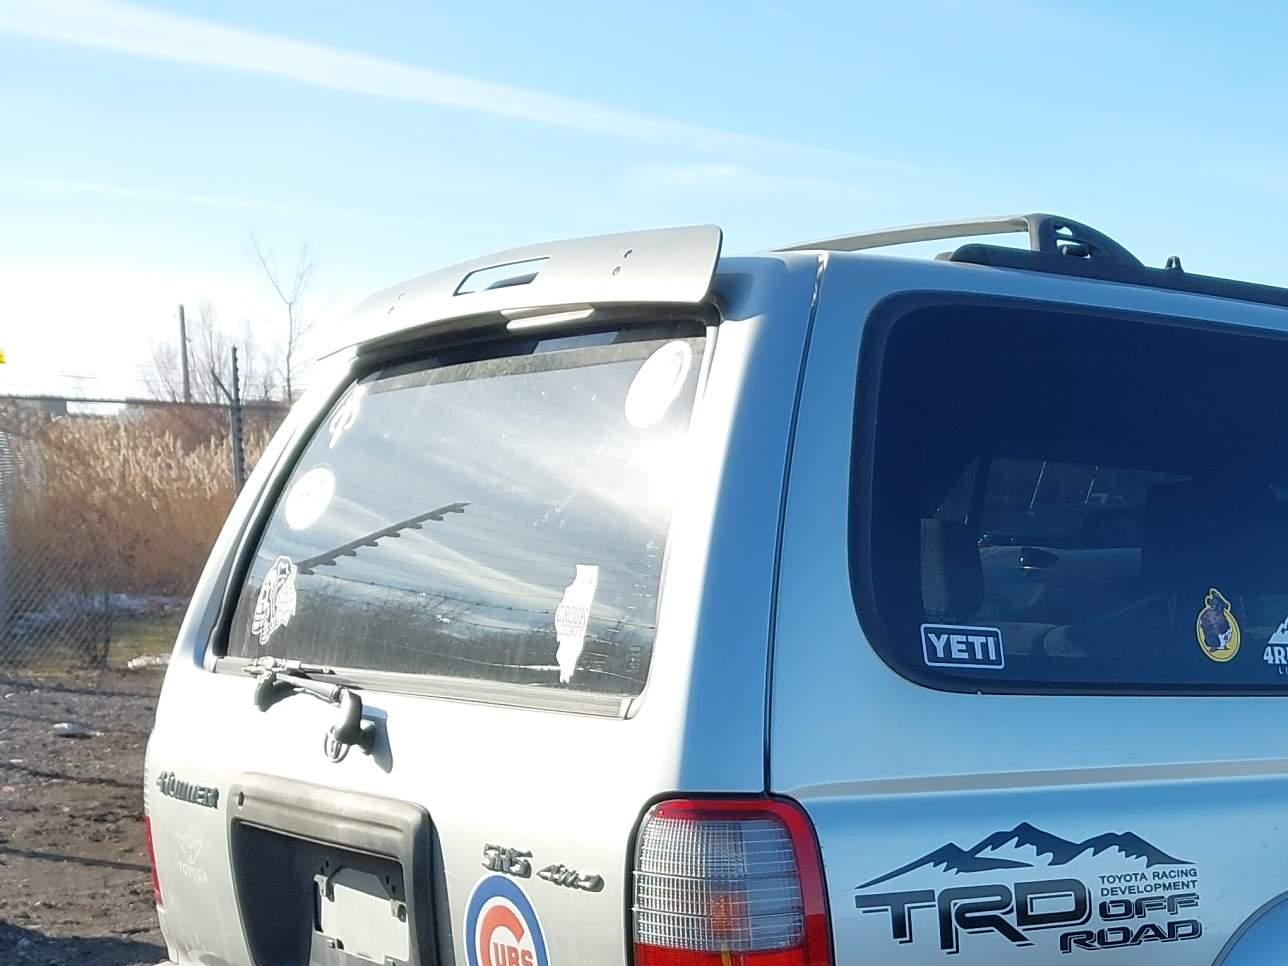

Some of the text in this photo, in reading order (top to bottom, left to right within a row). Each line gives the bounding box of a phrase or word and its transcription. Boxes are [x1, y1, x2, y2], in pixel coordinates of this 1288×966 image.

[927, 632, 997, 661] YETI
[1098, 868, 1198, 885] TOYOTA RACING
[1100, 880, 1198, 897] DEVELOPMENT
[855, 878, 1093, 955] TRD
[1098, 893, 1200, 922] OFF
[1060, 919, 1203, 954] ROAD
